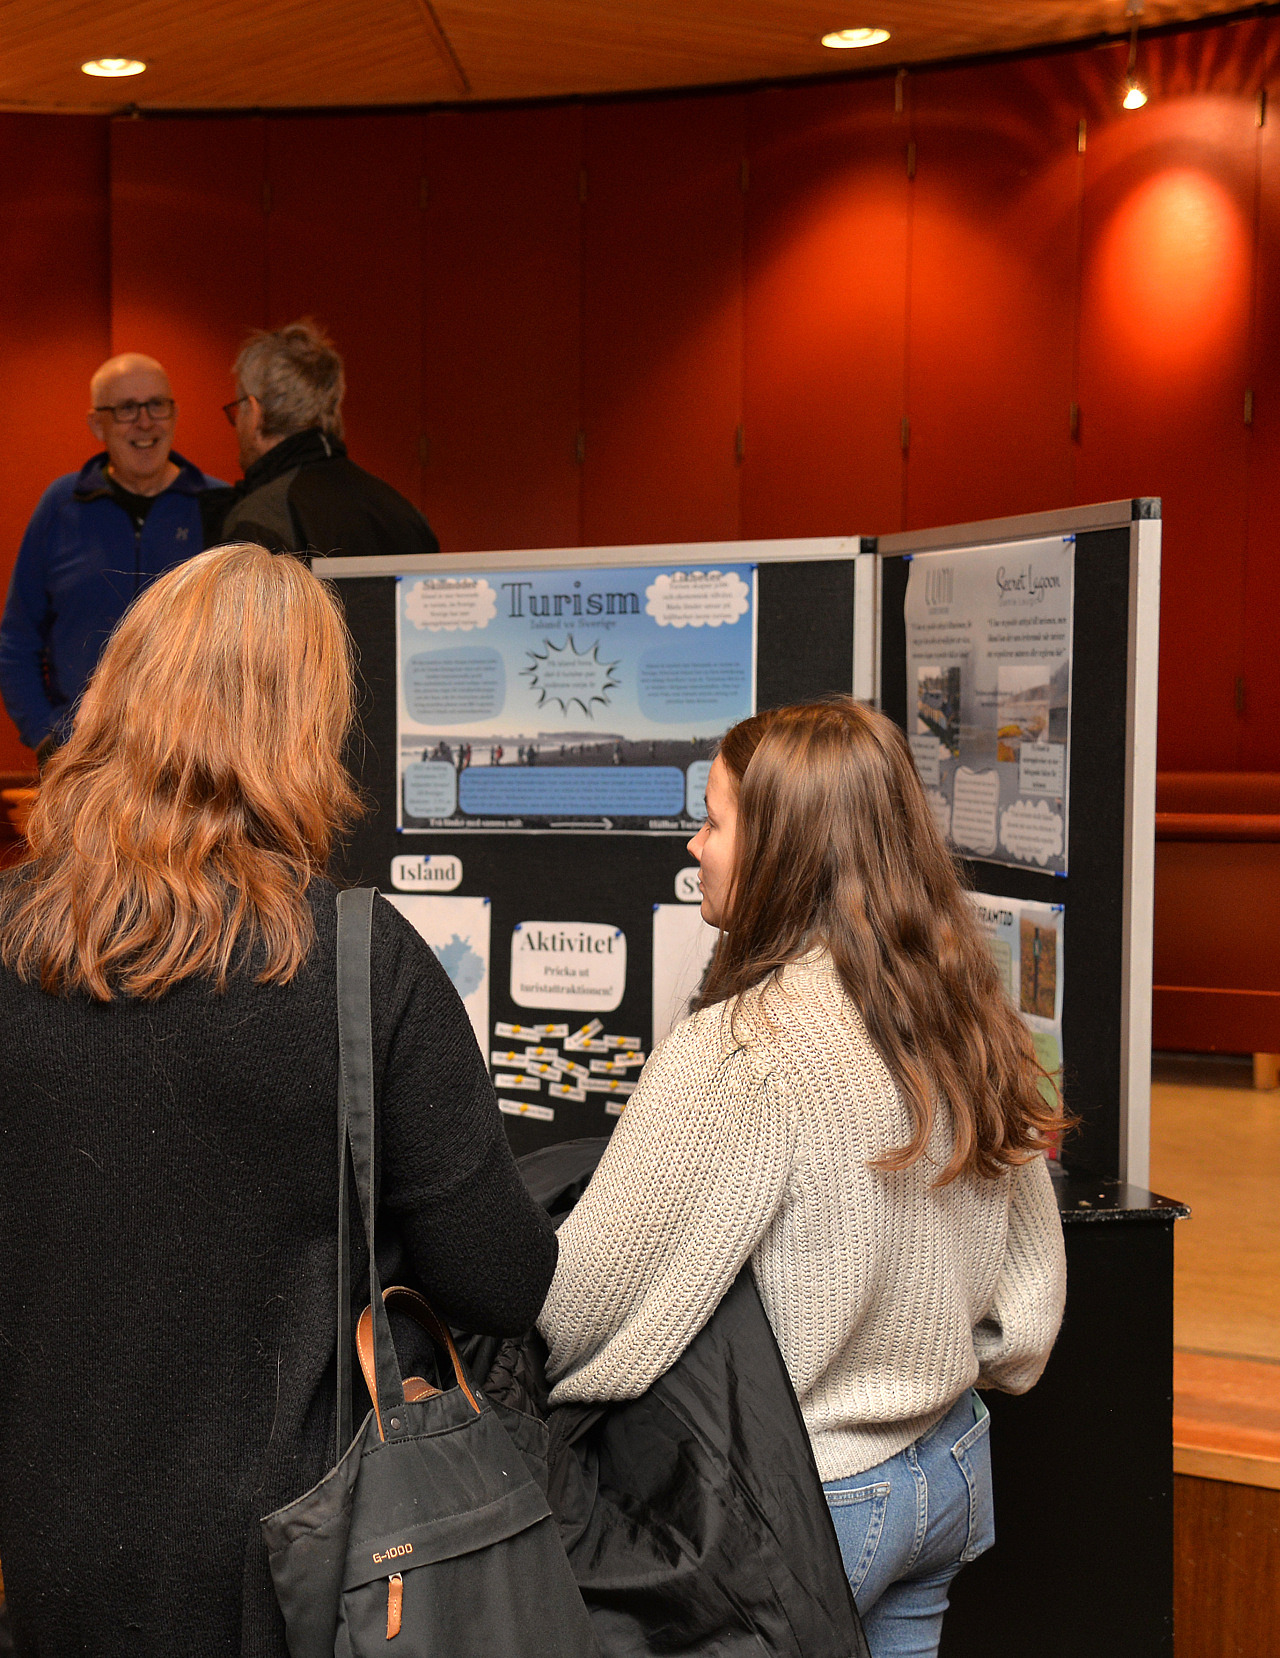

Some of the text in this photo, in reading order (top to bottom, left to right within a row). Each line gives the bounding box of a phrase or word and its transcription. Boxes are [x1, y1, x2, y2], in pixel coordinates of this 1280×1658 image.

[501, 580, 640, 618] Turism
[578, 618, 616, 631] Sverige
[400, 863, 456, 881] Island
[682, 876, 699, 894] S
[520, 931, 614, 954] Aktivitet
[543, 966, 589, 977] Pricka ut
[372, 1543, 414, 1564] G-1000
